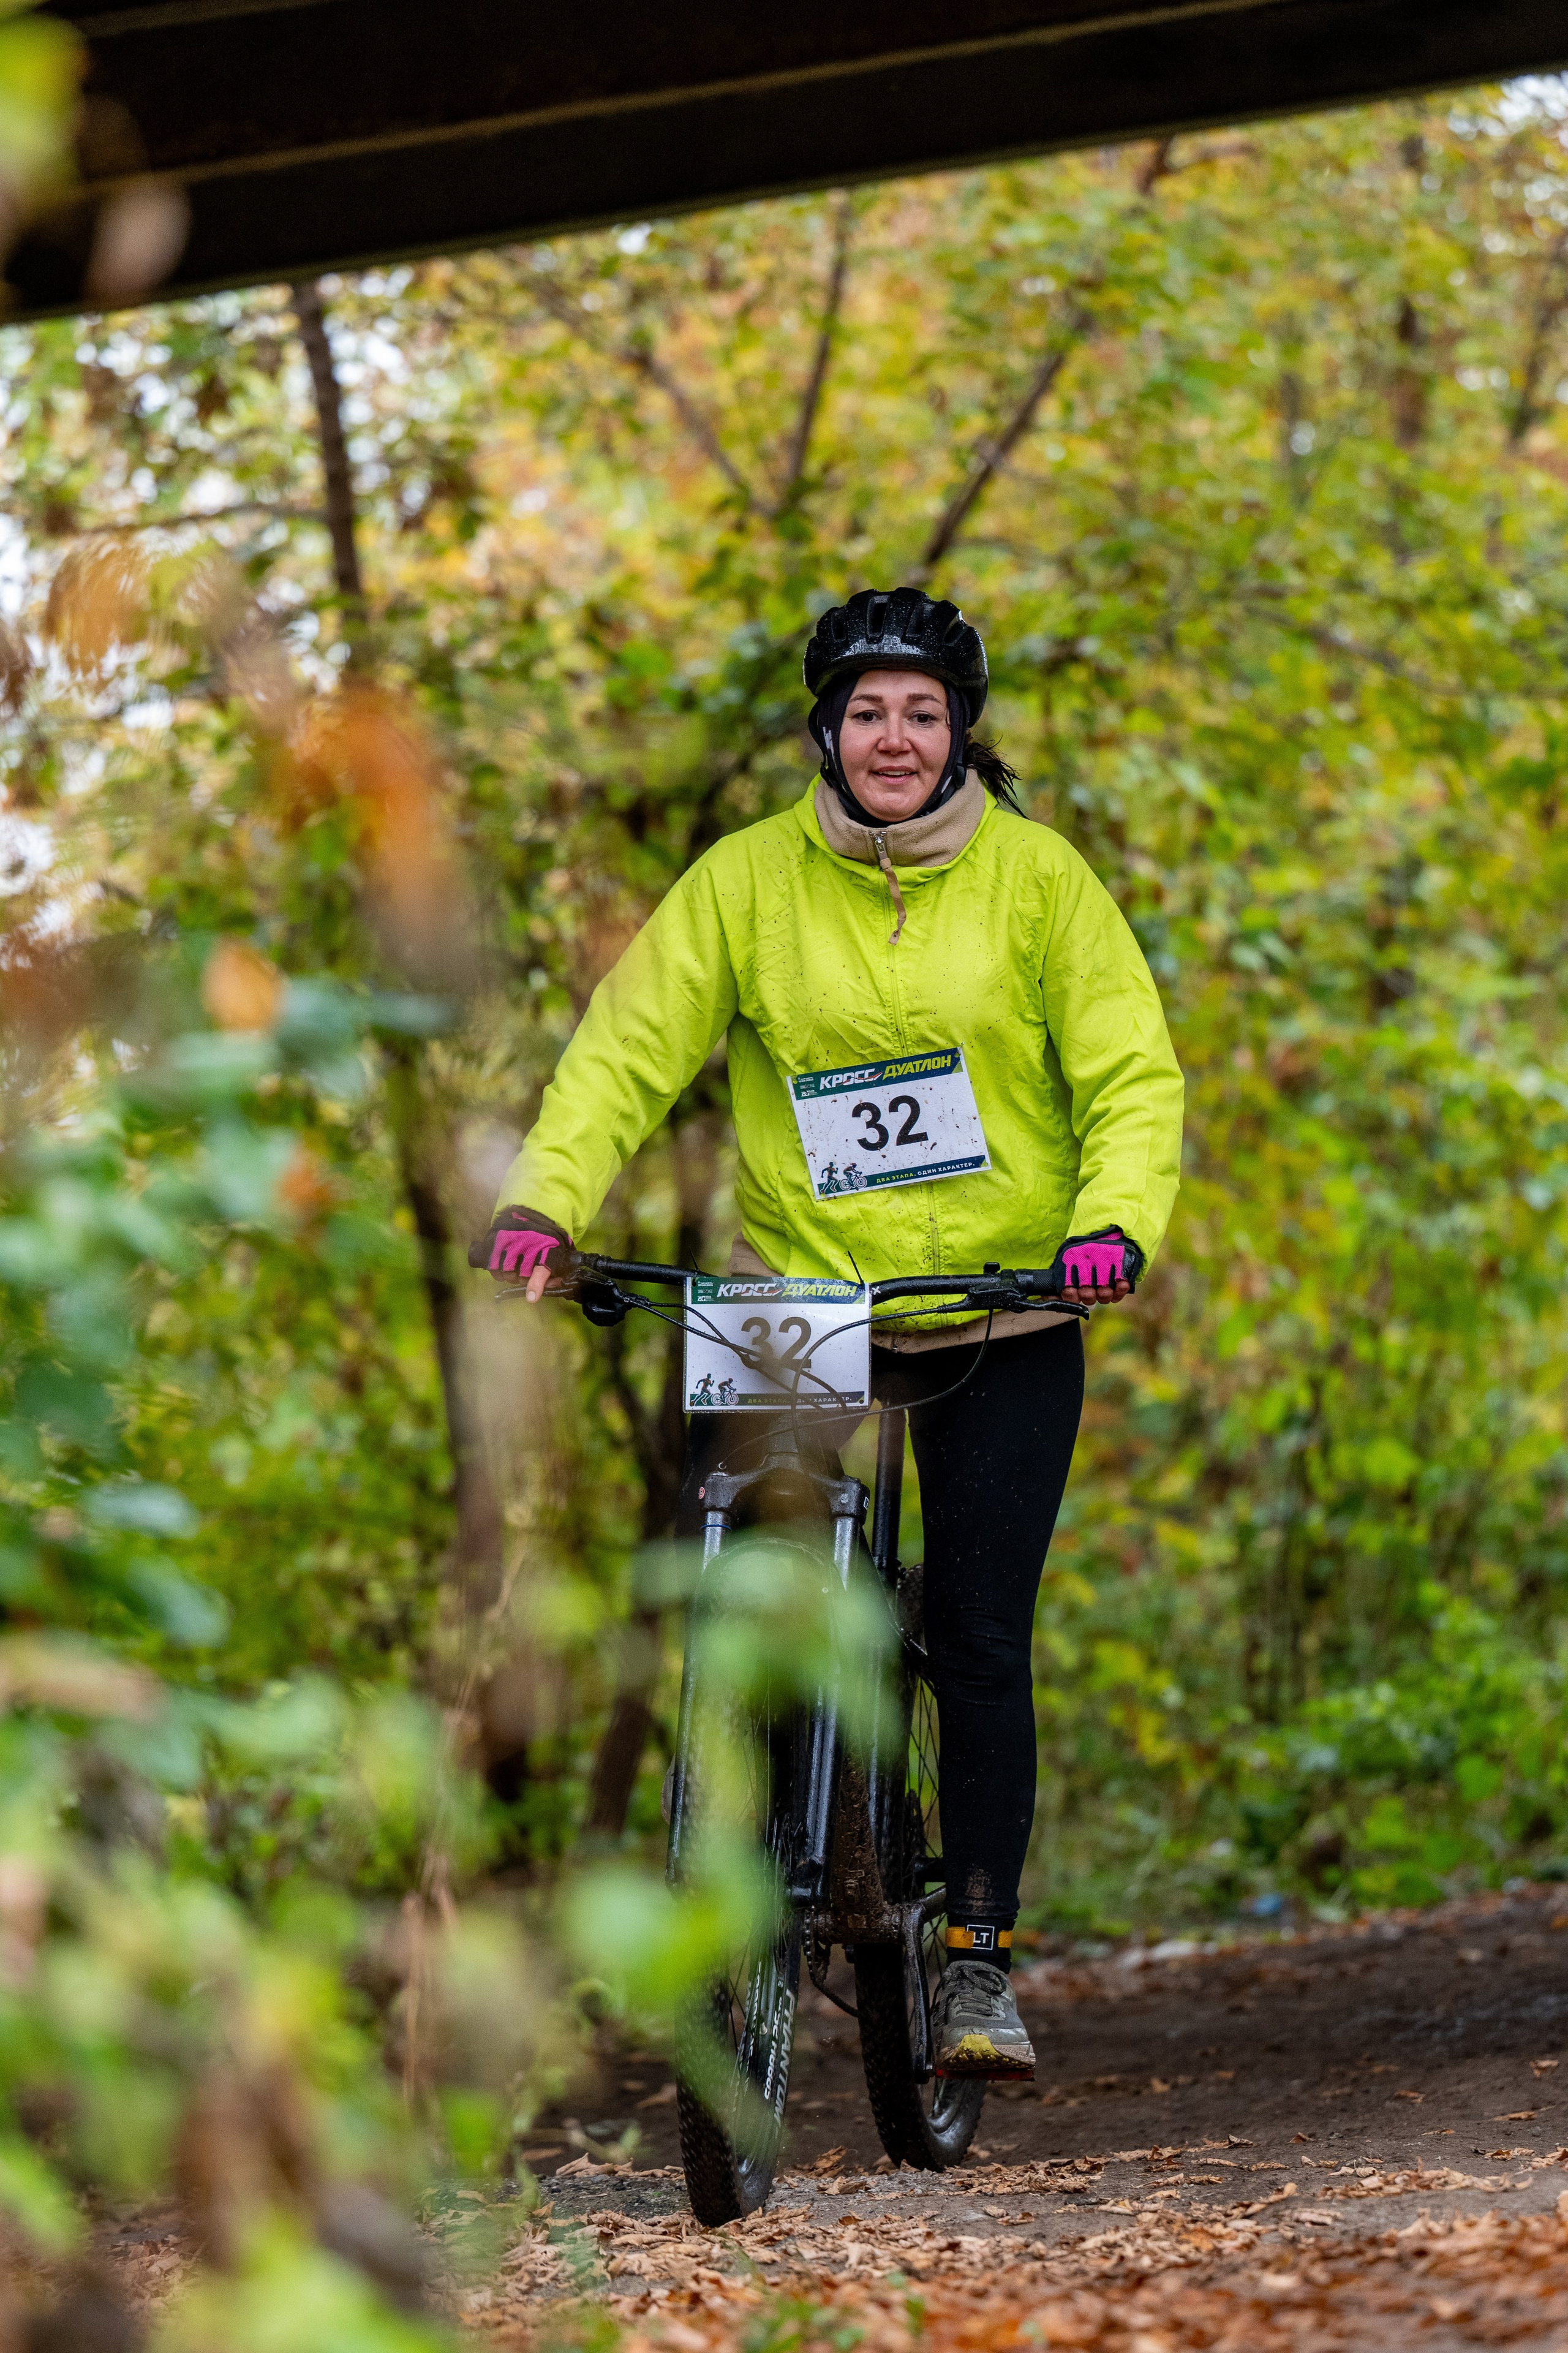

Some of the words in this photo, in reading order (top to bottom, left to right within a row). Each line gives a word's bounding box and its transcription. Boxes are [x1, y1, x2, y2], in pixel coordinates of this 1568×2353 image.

[820, 1068, 883, 1090] КРОСС
[882, 1055, 951, 1081] ДУАТЛОН
[851, 1095, 929, 1151] 32
[938, 1162, 975, 1172] ХАРАКТЕР.
[717, 1283, 783, 1297] КРОСС
[782, 1284, 858, 1297] ДУАТЛОН
[741, 1316, 812, 1369] 32
[973, 1932, 989, 1944] LT
[774, 1989, 796, 2128] PHANTOM
